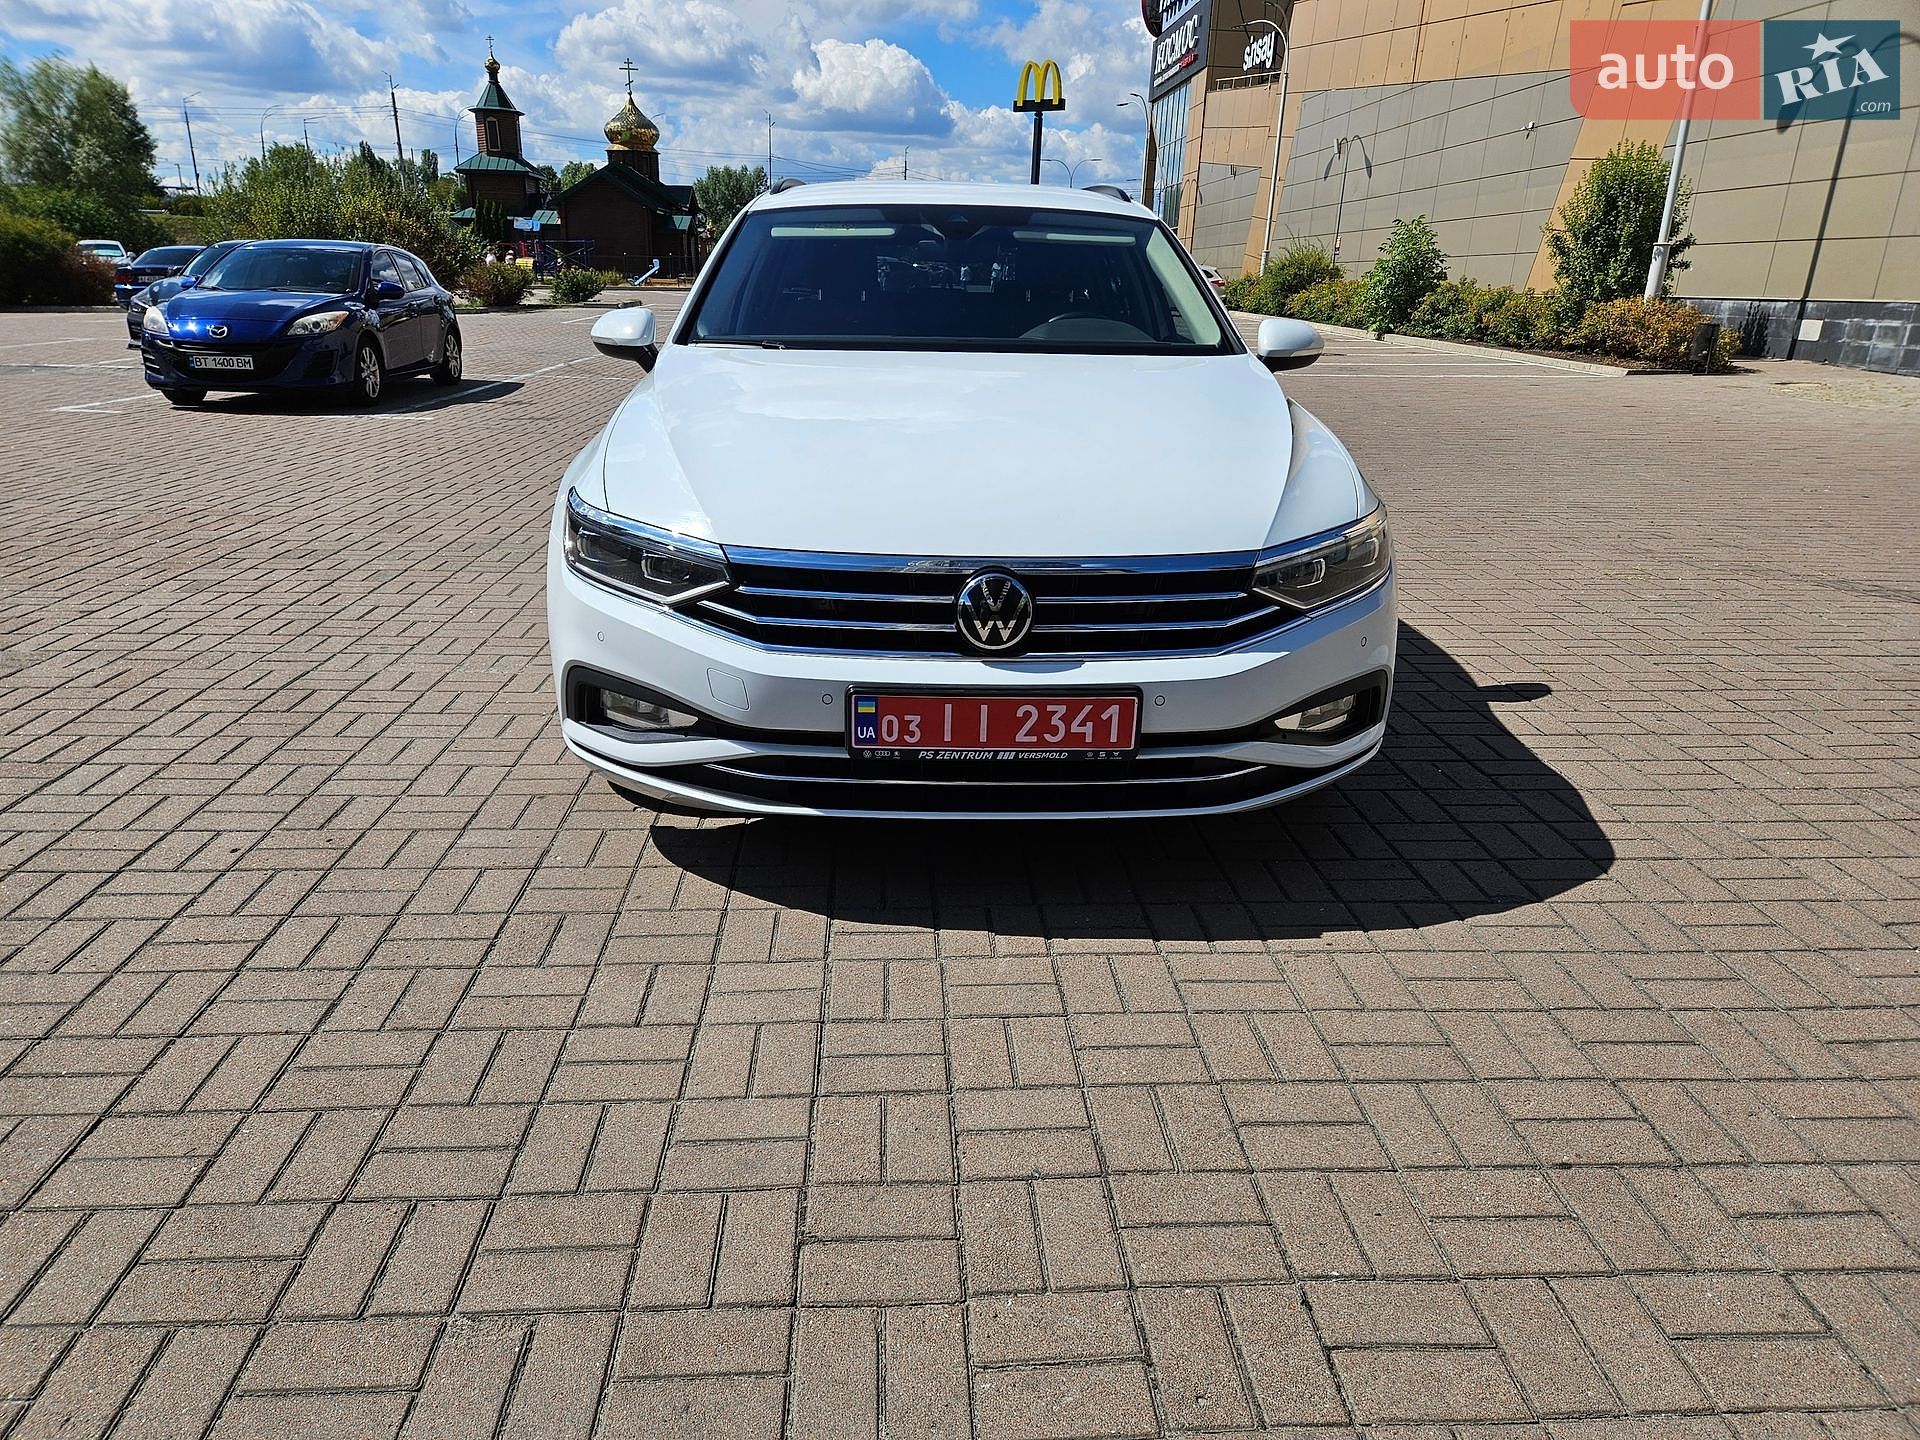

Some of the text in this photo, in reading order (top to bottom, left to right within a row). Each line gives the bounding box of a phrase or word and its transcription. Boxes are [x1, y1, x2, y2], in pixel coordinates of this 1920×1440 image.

[212, 357, 234, 368] 1400
[881, 714, 922, 743] 03
[1014, 704, 1121, 744] 2341
[857, 726, 876, 739] UA
[918, 751, 1068, 761] PS ZENTRUM VERSMOLD
